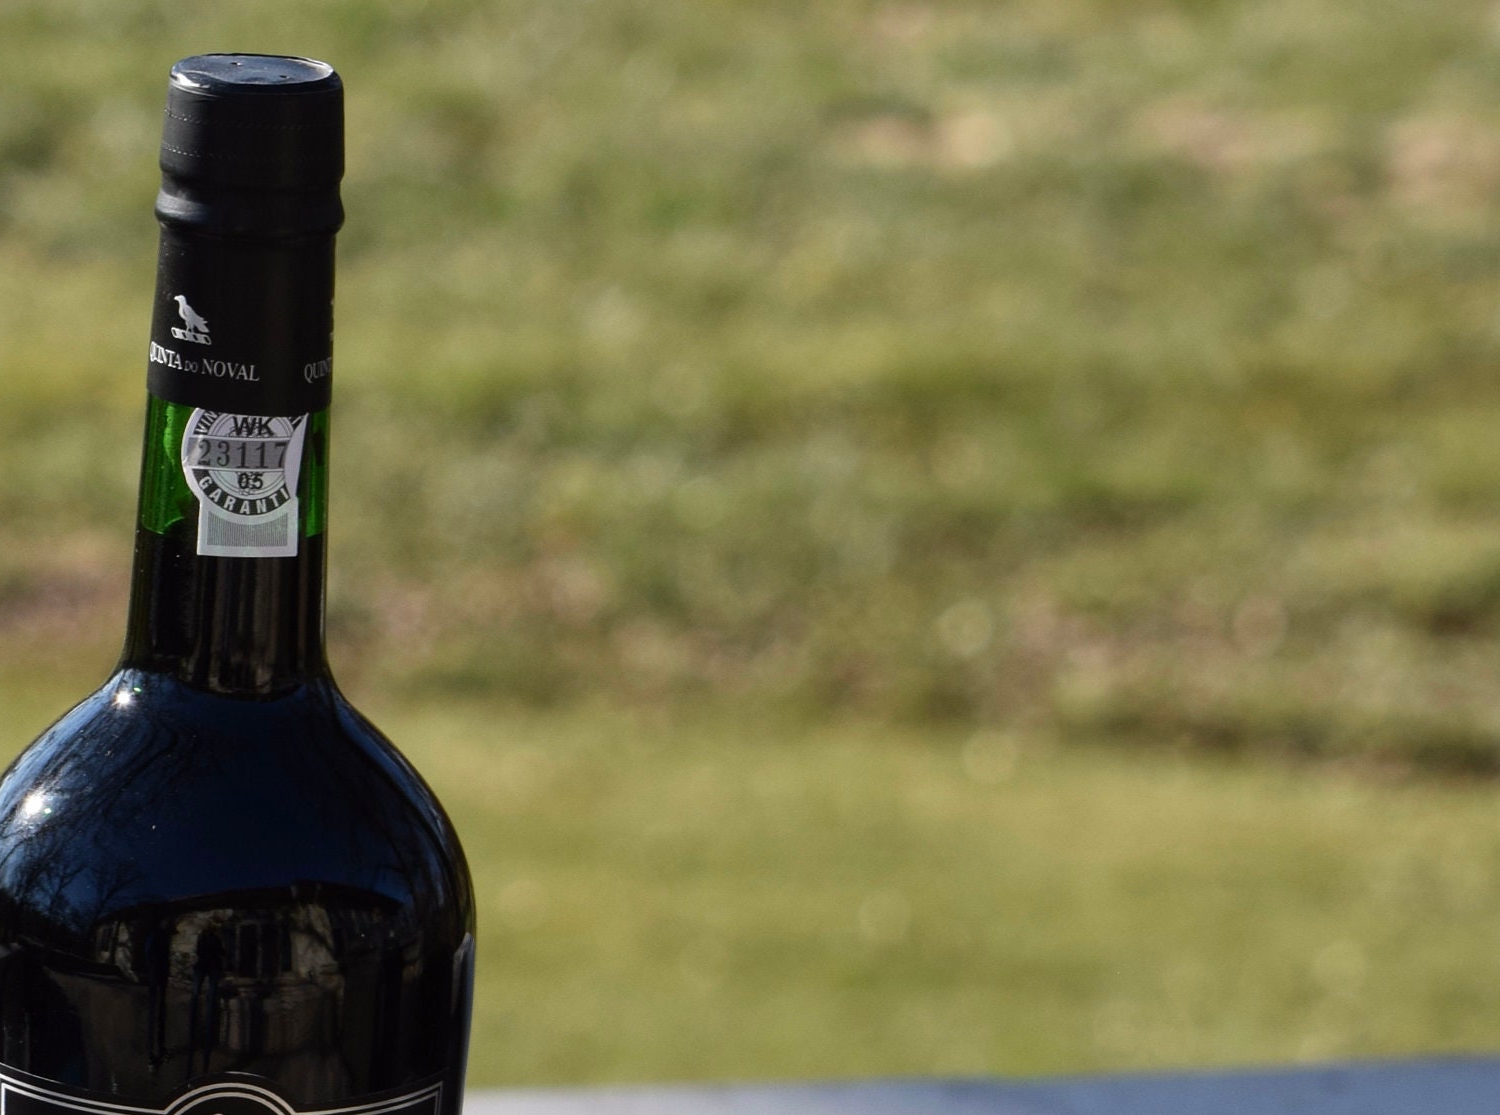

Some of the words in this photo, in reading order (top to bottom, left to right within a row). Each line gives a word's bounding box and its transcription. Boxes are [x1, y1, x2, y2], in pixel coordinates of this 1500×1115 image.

[184, 360, 198, 373] DO
[201, 358, 260, 382] NOVAL
[194, 409, 220, 434] VIN
[197, 439, 288, 468] 23117
